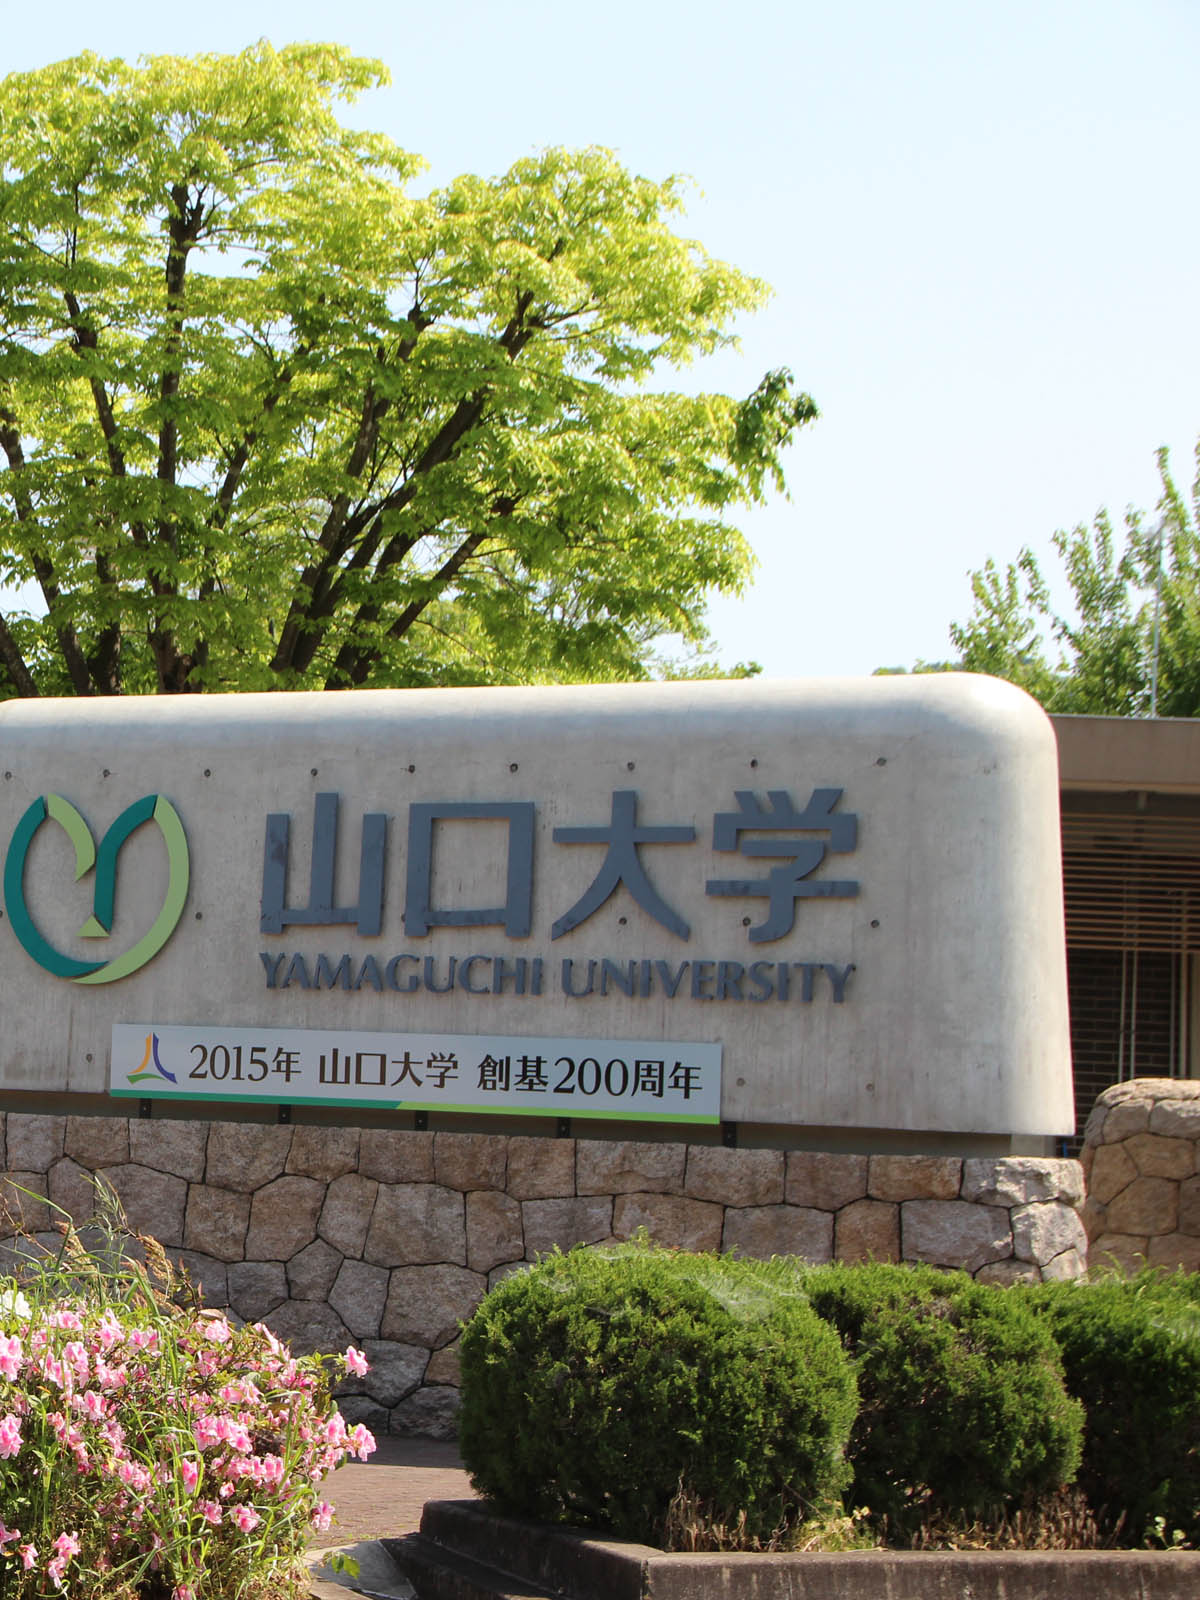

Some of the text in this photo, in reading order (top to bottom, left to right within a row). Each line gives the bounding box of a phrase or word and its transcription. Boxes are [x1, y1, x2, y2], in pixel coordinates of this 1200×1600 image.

[260, 788, 860, 942] 山口大学
[259, 951, 857, 1004] YAMAGUCHI UNIVERSITY
[188, 1044, 704, 1100] 2015年 山口大学 創基200周年
